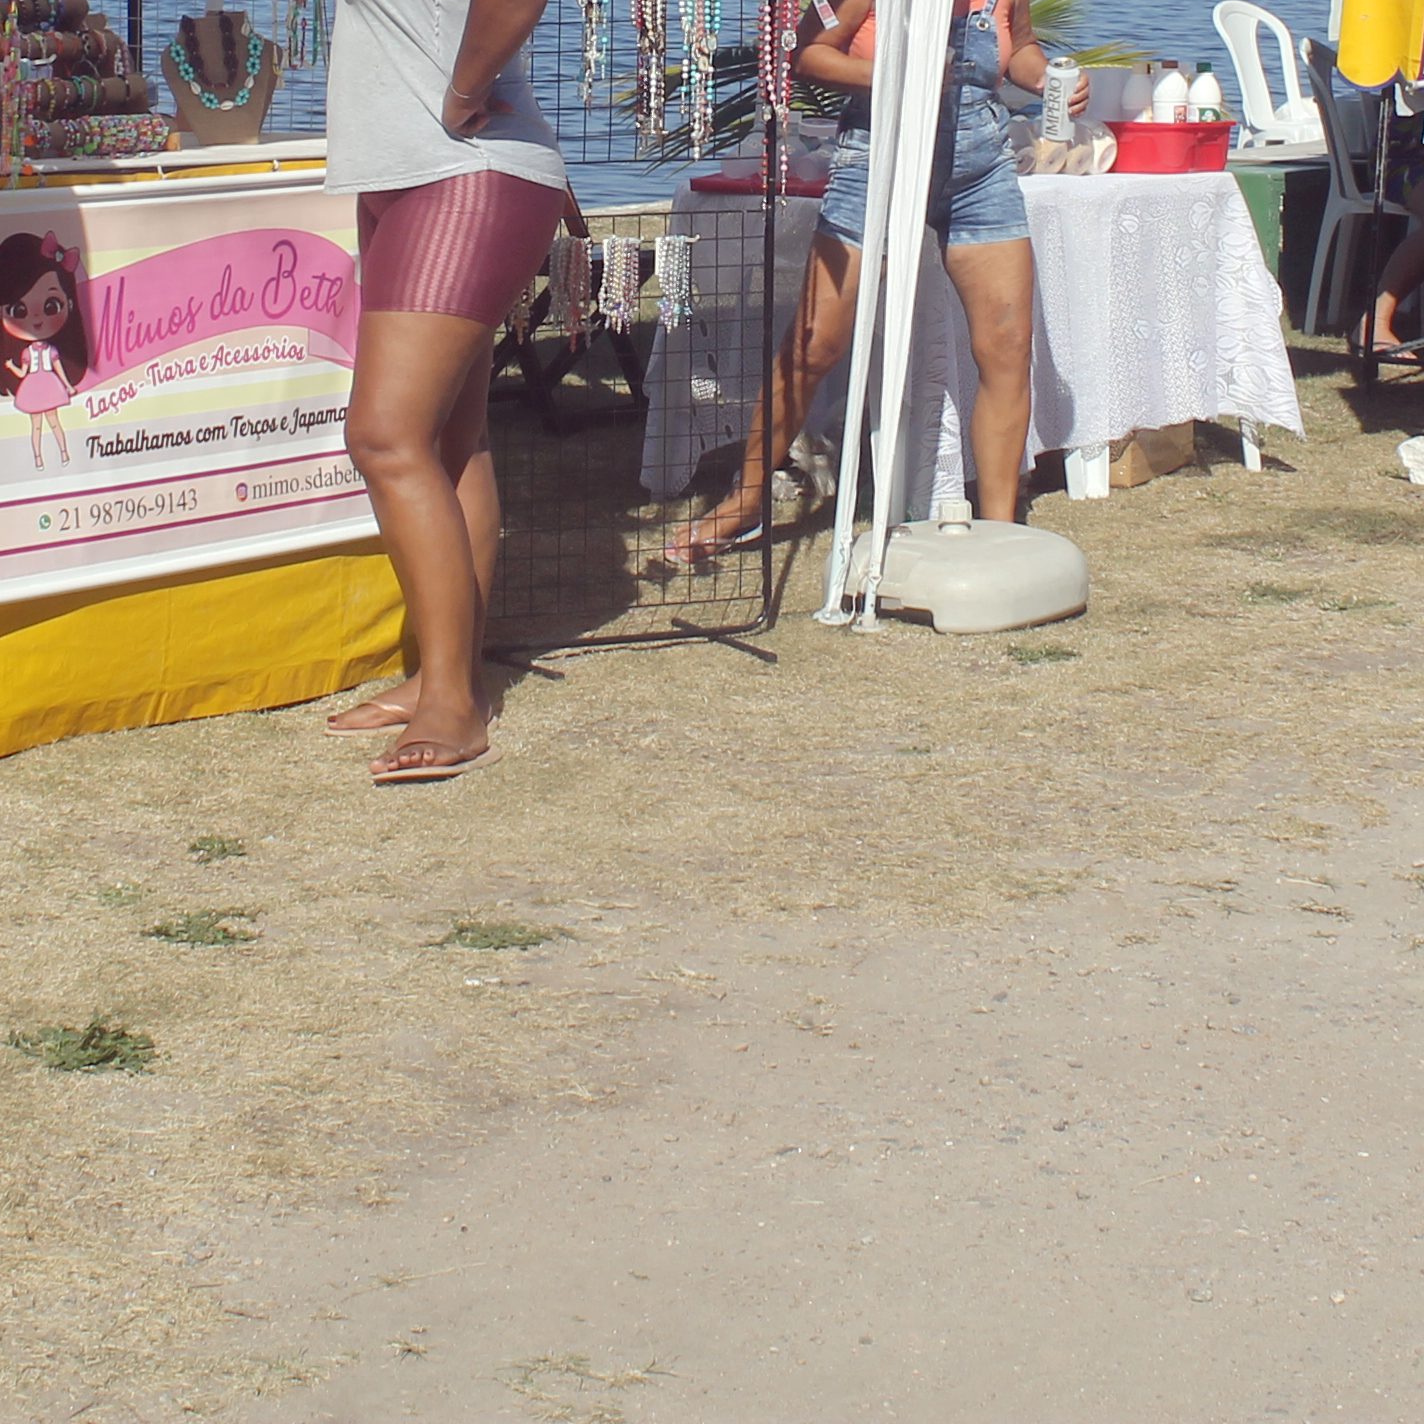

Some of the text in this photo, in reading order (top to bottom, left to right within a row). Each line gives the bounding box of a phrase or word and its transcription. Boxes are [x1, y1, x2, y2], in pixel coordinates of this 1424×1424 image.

[94, 239, 345, 366] Mimos da Beth
[85, 381, 138, 421] Laços
[146, 358, 197, 387] Tiara
[199, 359, 209, 371] e
[209, 337, 306, 372] Acessórios
[86, 428, 194, 460] Trabalhamos
[195, 424, 226, 443] com
[230, 415, 278, 442] Terços
[280, 416, 290, 431] e
[58, 488, 199, 532] 21 98796-9143
